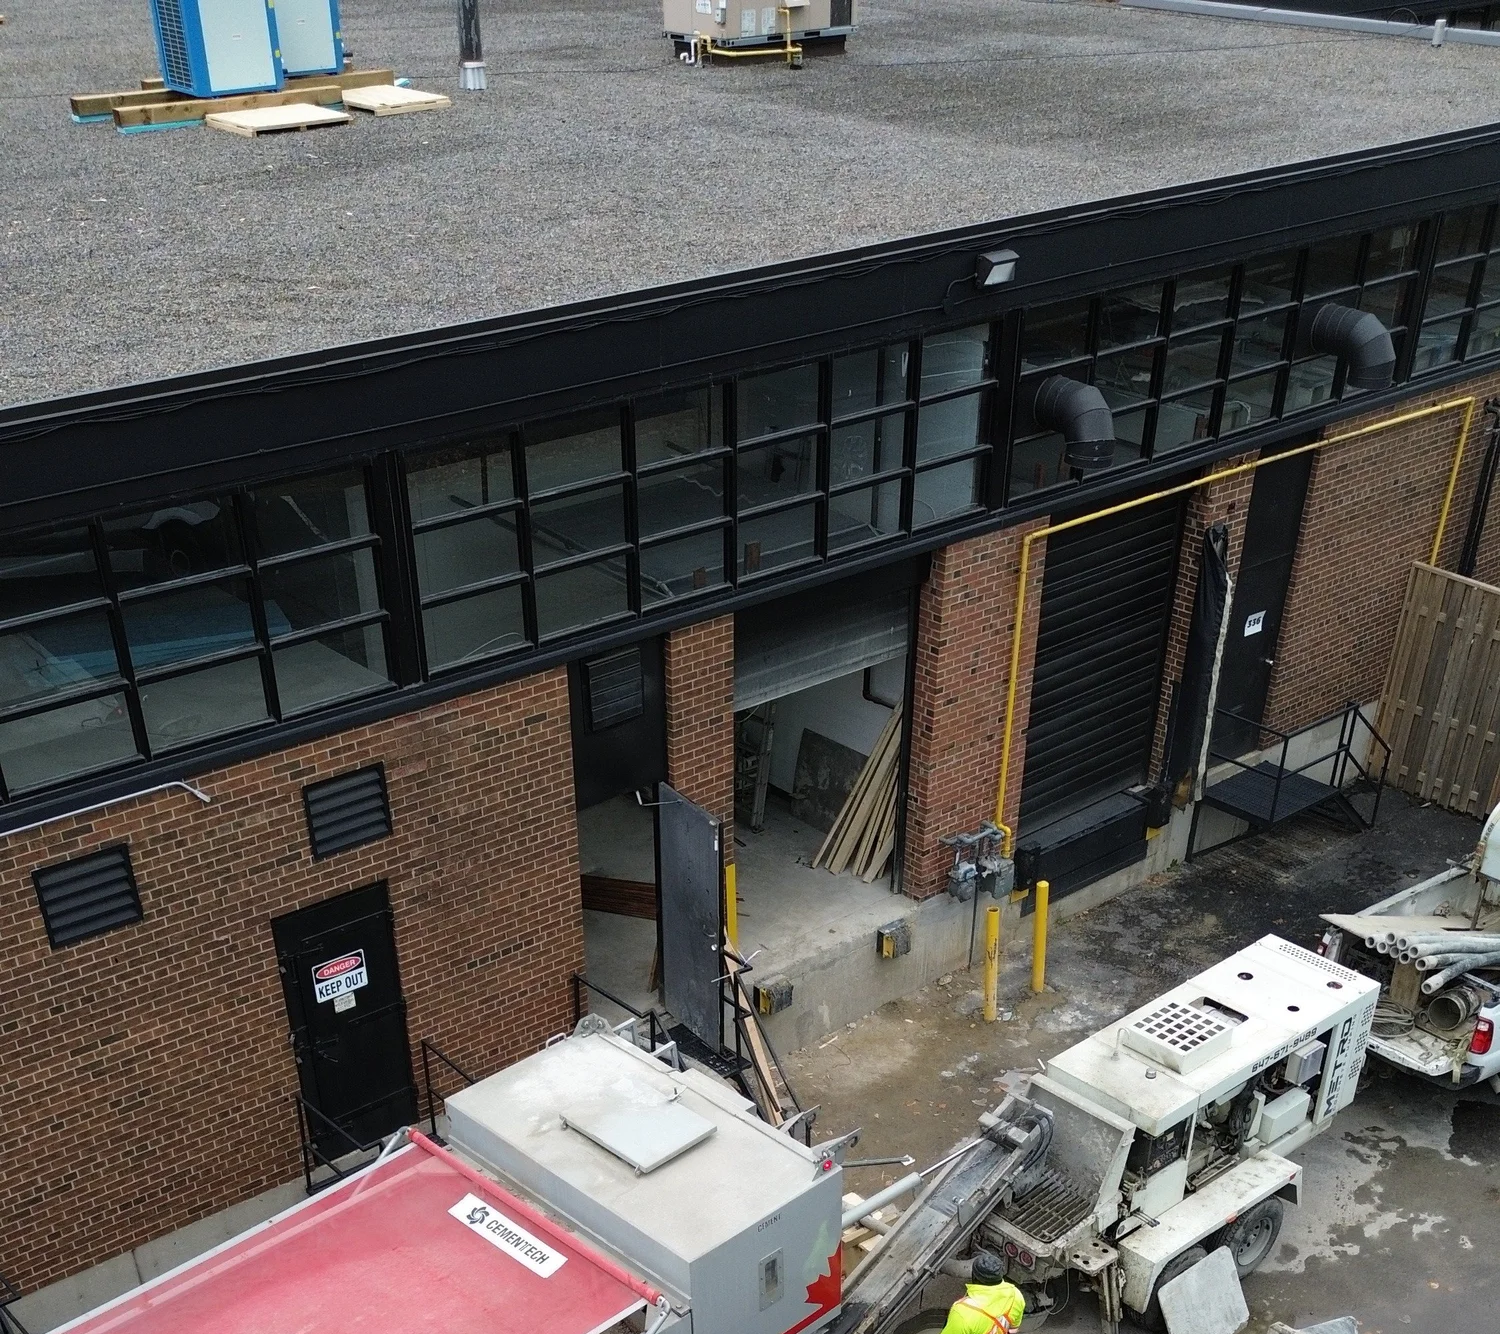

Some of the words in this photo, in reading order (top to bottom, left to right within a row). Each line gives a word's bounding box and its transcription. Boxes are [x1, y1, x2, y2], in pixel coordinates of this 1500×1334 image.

[323, 959, 356, 976] DANGER
[318, 979, 342, 999] KEEP
[345, 971, 364, 989] OUT
[1251, 1027, 1318, 1073] 647-671-9489
[1323, 1016, 1353, 1117] METRO
[757, 1212, 781, 1232] CEMENT
